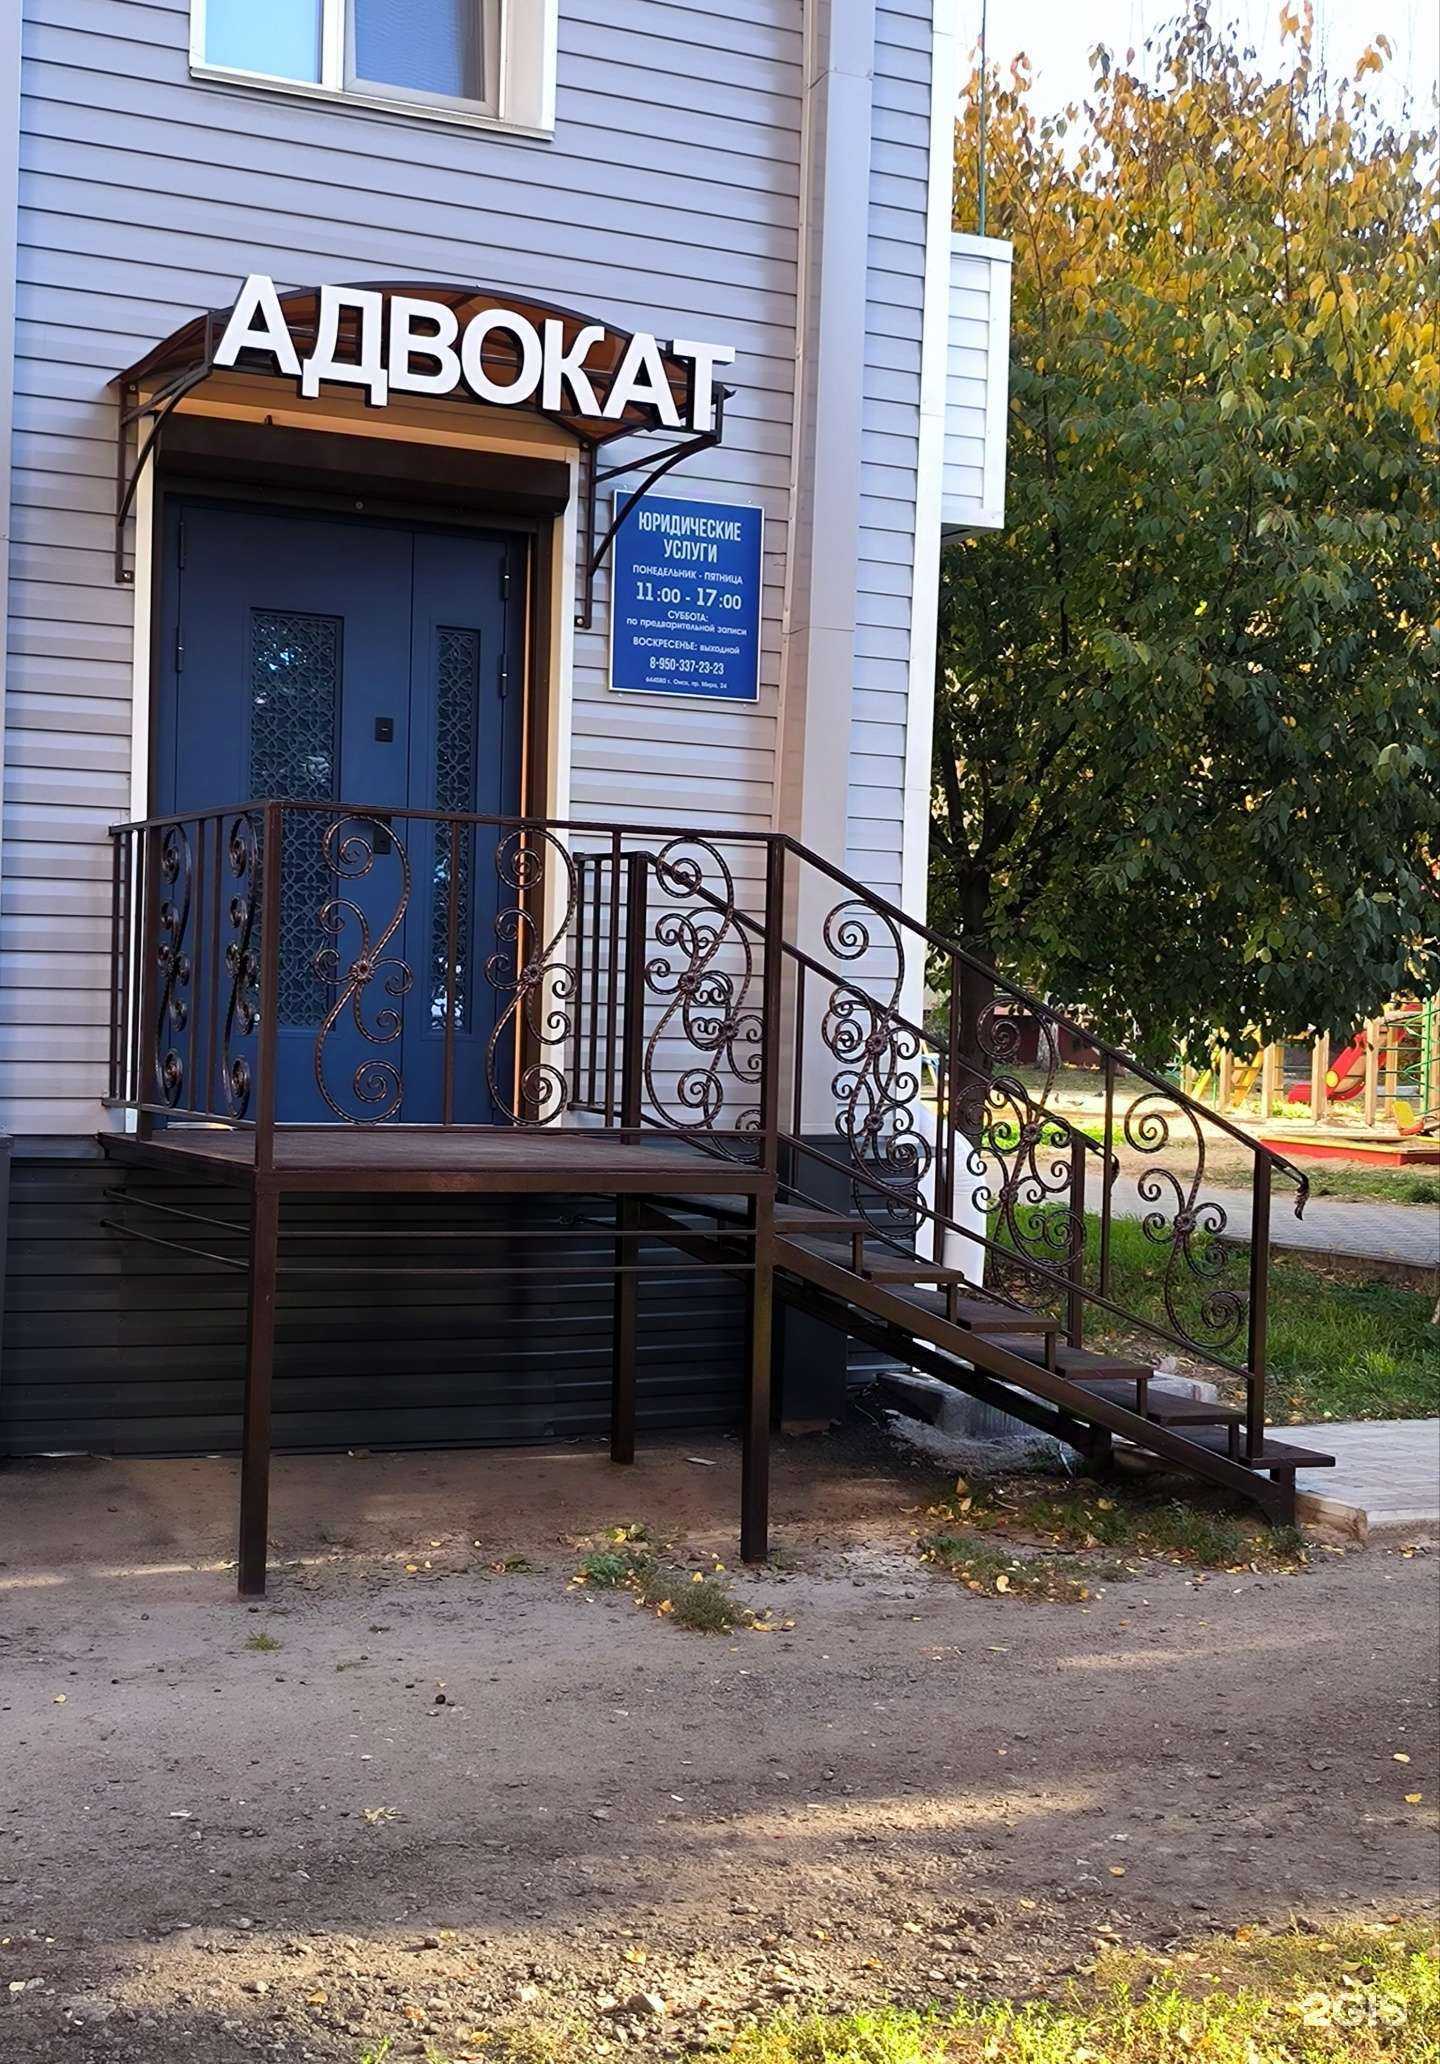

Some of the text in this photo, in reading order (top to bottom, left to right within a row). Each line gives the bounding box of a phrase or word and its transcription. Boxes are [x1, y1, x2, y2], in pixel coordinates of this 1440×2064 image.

[212, 274, 736, 432] АДВОКАТ
[638, 511, 742, 541] ЮРИДИЧЕСКИЕ
[663, 538, 718, 563] УСЛУГИ
[632, 564, 697, 579] ПОНЕДЕЛЬНИК
[704, 571, 743, 585] ПЯТНИЦА
[636, 581, 681, 604] 11:00
[696, 587, 742, 610] 17:00
[667, 609, 709, 622] СУББОТА:
[626, 617, 748, 636] по предварительной записи
[633, 636, 741, 655] ВОСКРЕСЕНЬЕ: выходной
[649, 656, 725, 675] 8-950-337-23-23
